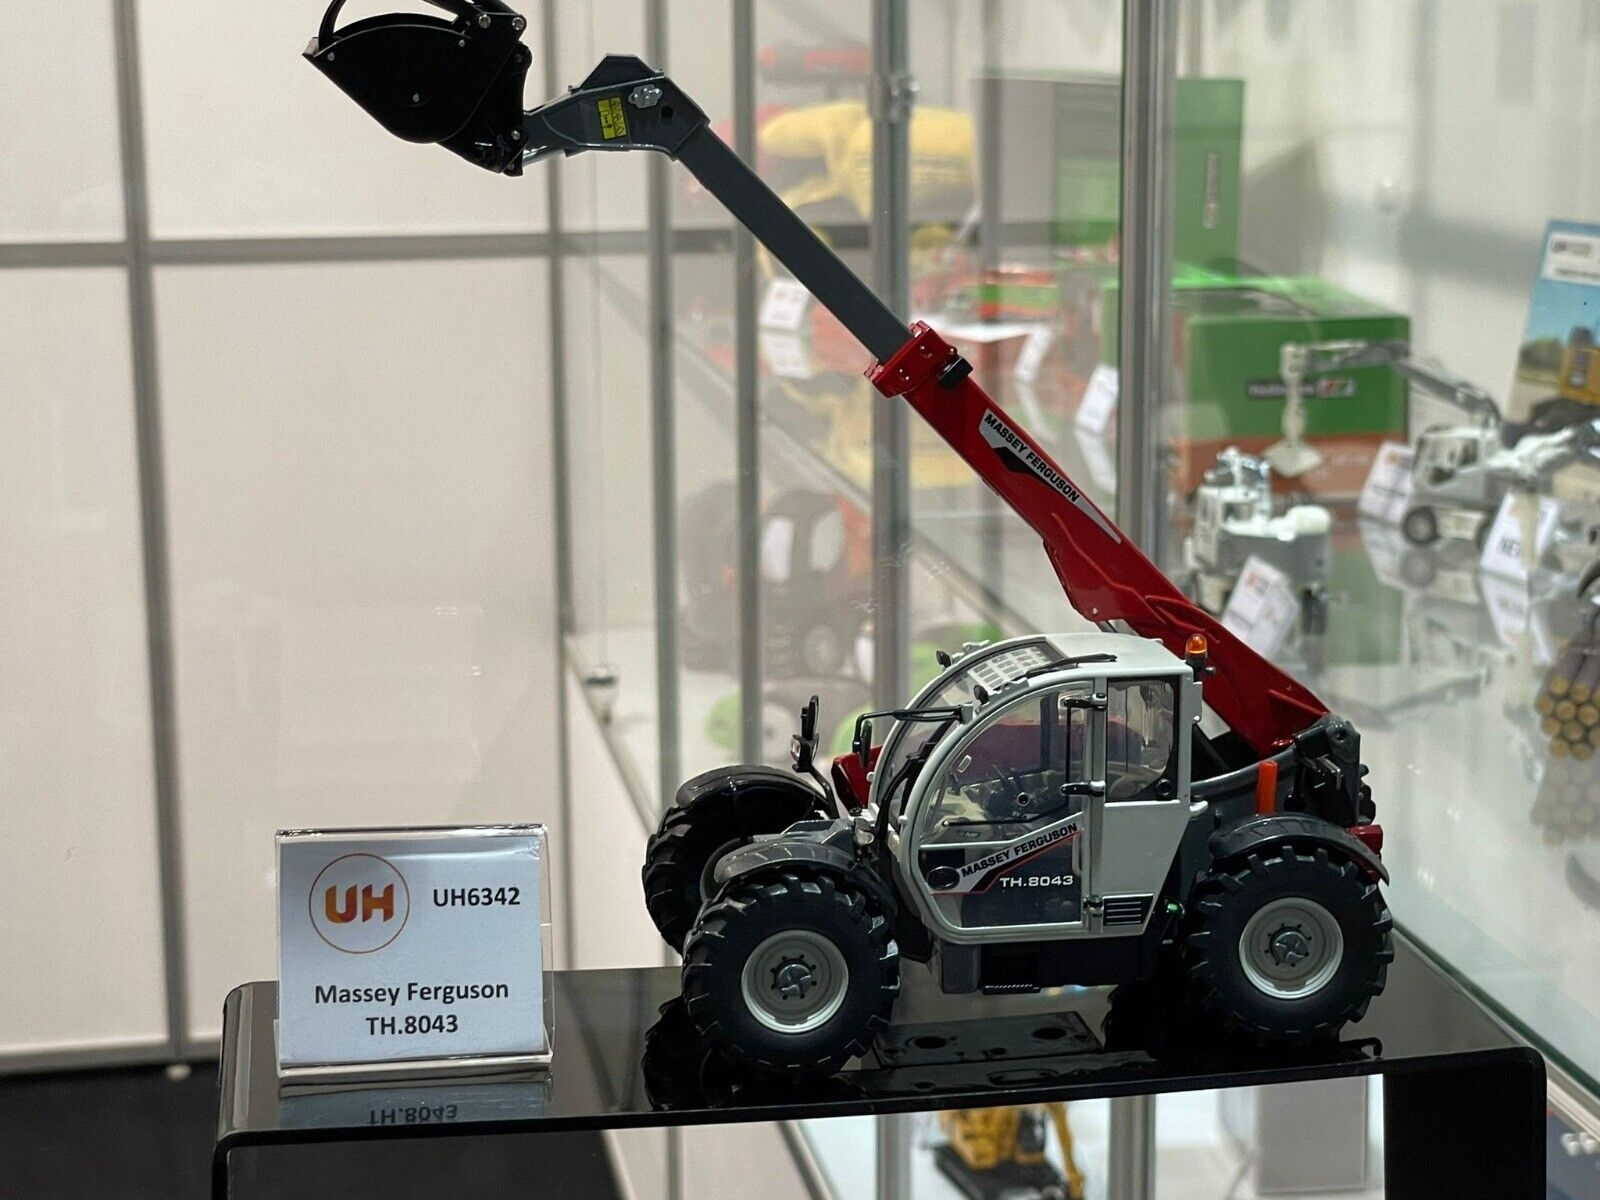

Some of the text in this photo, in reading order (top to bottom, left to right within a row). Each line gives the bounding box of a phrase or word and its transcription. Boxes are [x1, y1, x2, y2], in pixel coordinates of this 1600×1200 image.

[984, 413, 1080, 502] MASSEY FERGUSON
[960, 823, 1078, 878] MASSEY FERGUSON
[1000, 875, 1074, 888] TH.8043
[325, 883, 394, 923] UH
[433, 887, 521, 907] UH6342
[315, 982, 509, 1006] Massey Ferguson
[366, 1015, 458, 1035] TH.8043
